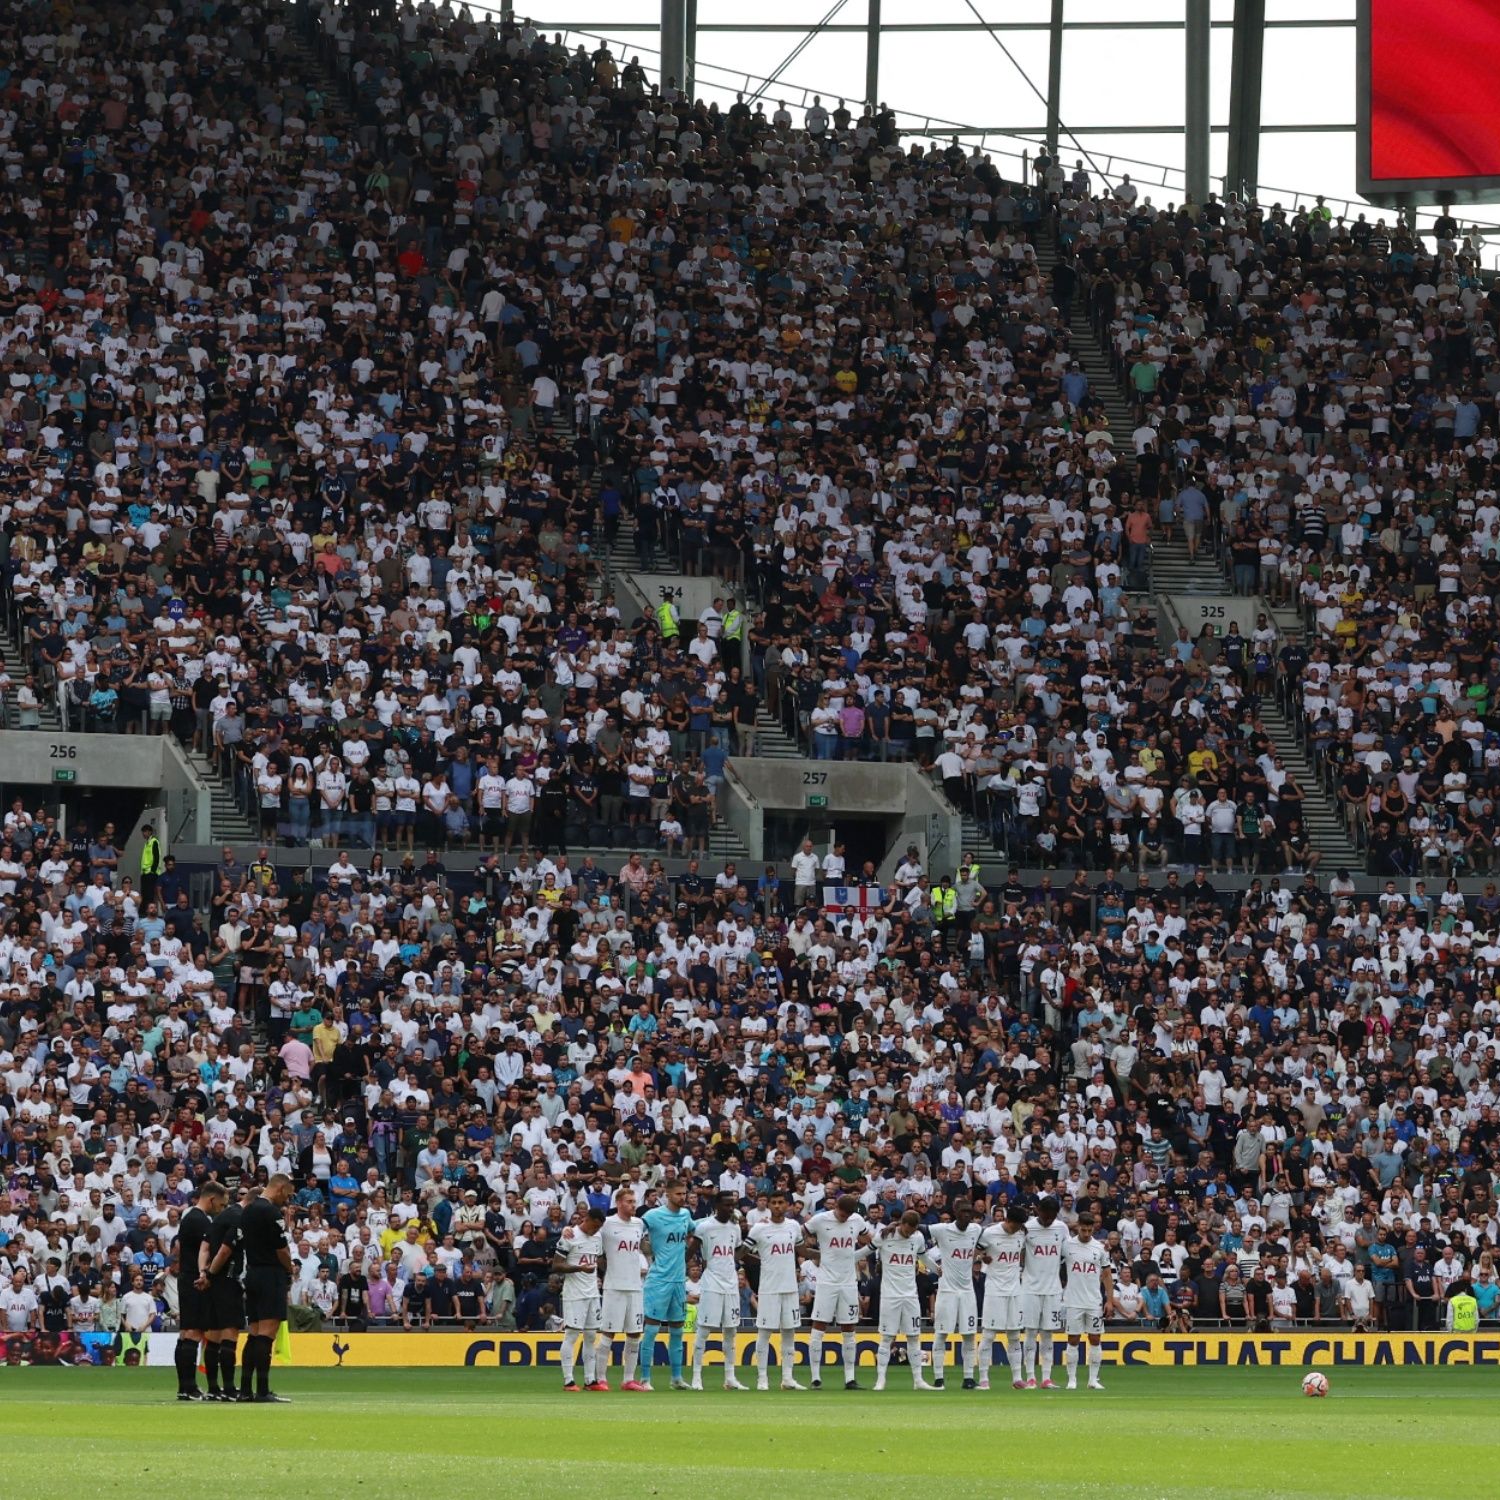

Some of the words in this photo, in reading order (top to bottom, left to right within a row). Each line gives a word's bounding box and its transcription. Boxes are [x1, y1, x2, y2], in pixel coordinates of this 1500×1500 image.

[659, 585, 683, 598] 324
[1201, 605, 1225, 618] 325
[50, 744, 77, 759] 256
[803, 772, 828, 785] 257
[667, 1232, 686, 1243] AIA
[829, 1236, 853, 1248] AIA
[618, 1240, 640, 1251] AIA
[712, 1245, 735, 1256] AIA
[771, 1243, 794, 1255] AIA
[1034, 1245, 1058, 1256] AIA
[889, 1253, 914, 1265] AIA
[952, 1248, 973, 1260] AIA
[998, 1251, 1020, 1263] AIA
[1072, 1261, 1097, 1273] AIA
[912, 1316, 920, 1328] 10
[968, 1316, 975, 1328] 8
[1052, 1311, 1062, 1323] 38
[1164, 1340, 1291, 1365] THAT
[1303, 1339, 1500, 1365] CHANGE
